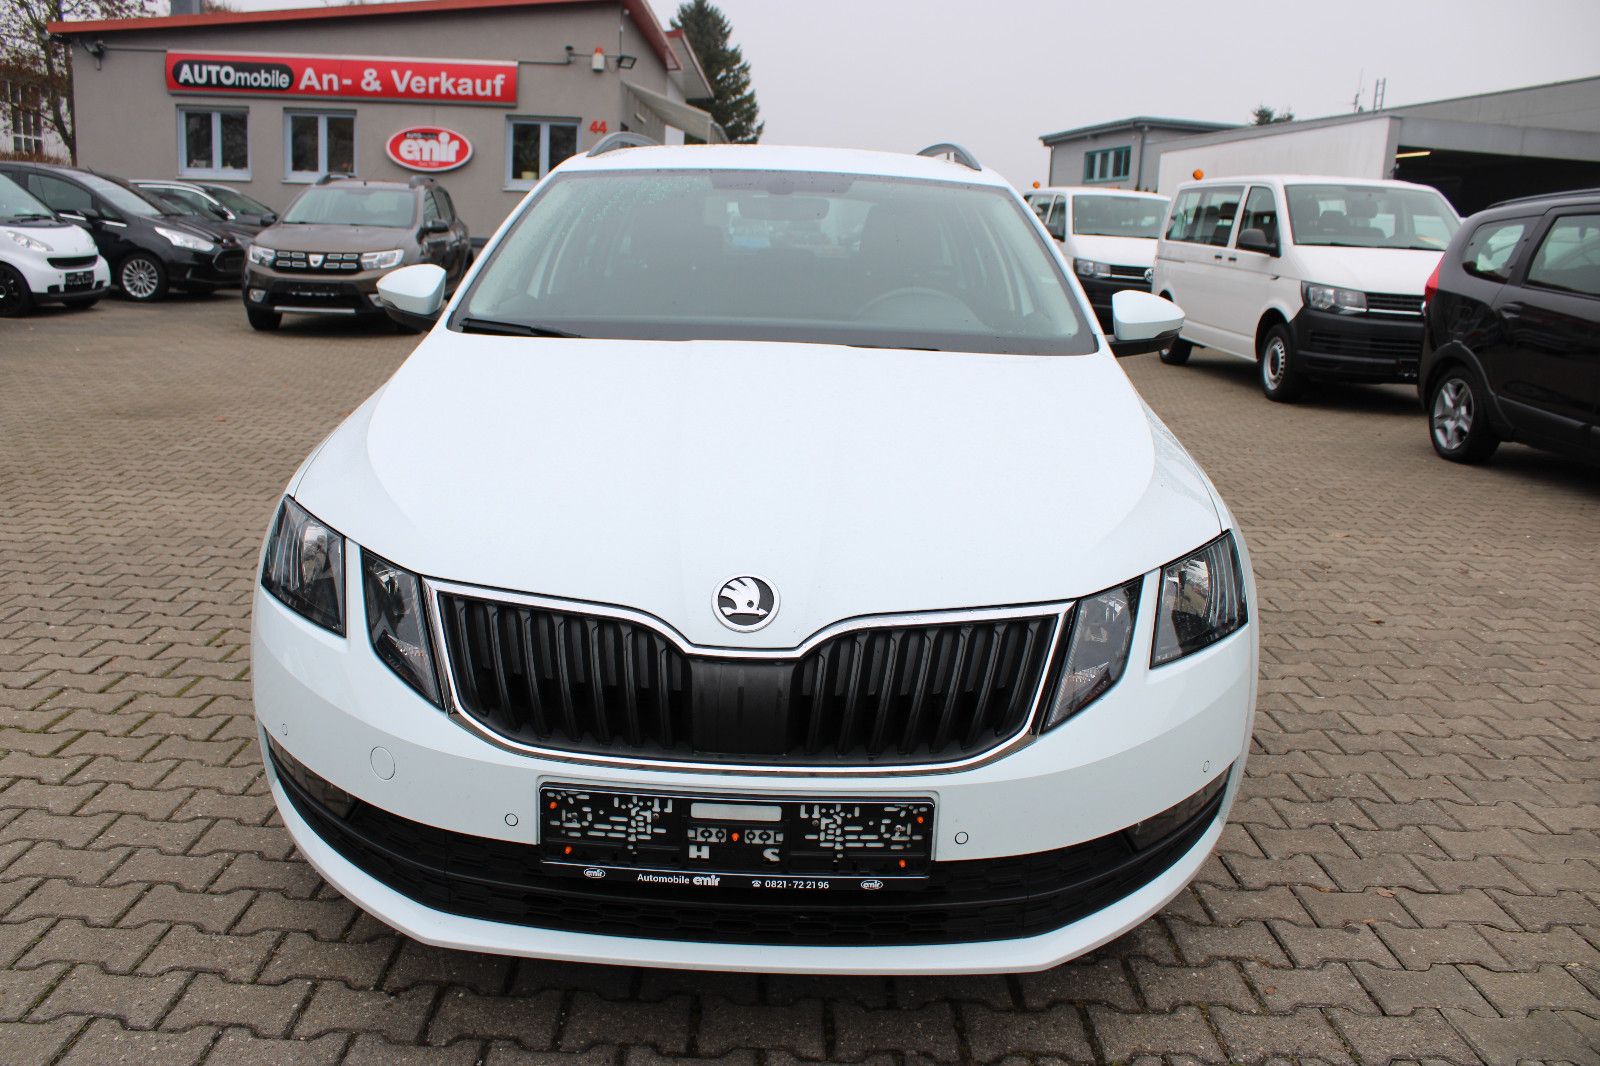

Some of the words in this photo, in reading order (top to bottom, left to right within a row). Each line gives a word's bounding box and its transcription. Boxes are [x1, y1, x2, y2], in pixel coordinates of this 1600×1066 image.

[179, 63, 290, 88] AUTOmobile
[299, 67, 353, 91] An-
[360, 68, 382, 92] &
[390, 69, 506, 97] Verkauf
[591, 120, 607, 133] 44
[399, 132, 460, 162] emir
[637, 874, 690, 884] Automobile
[693, 875, 720, 886] emir
